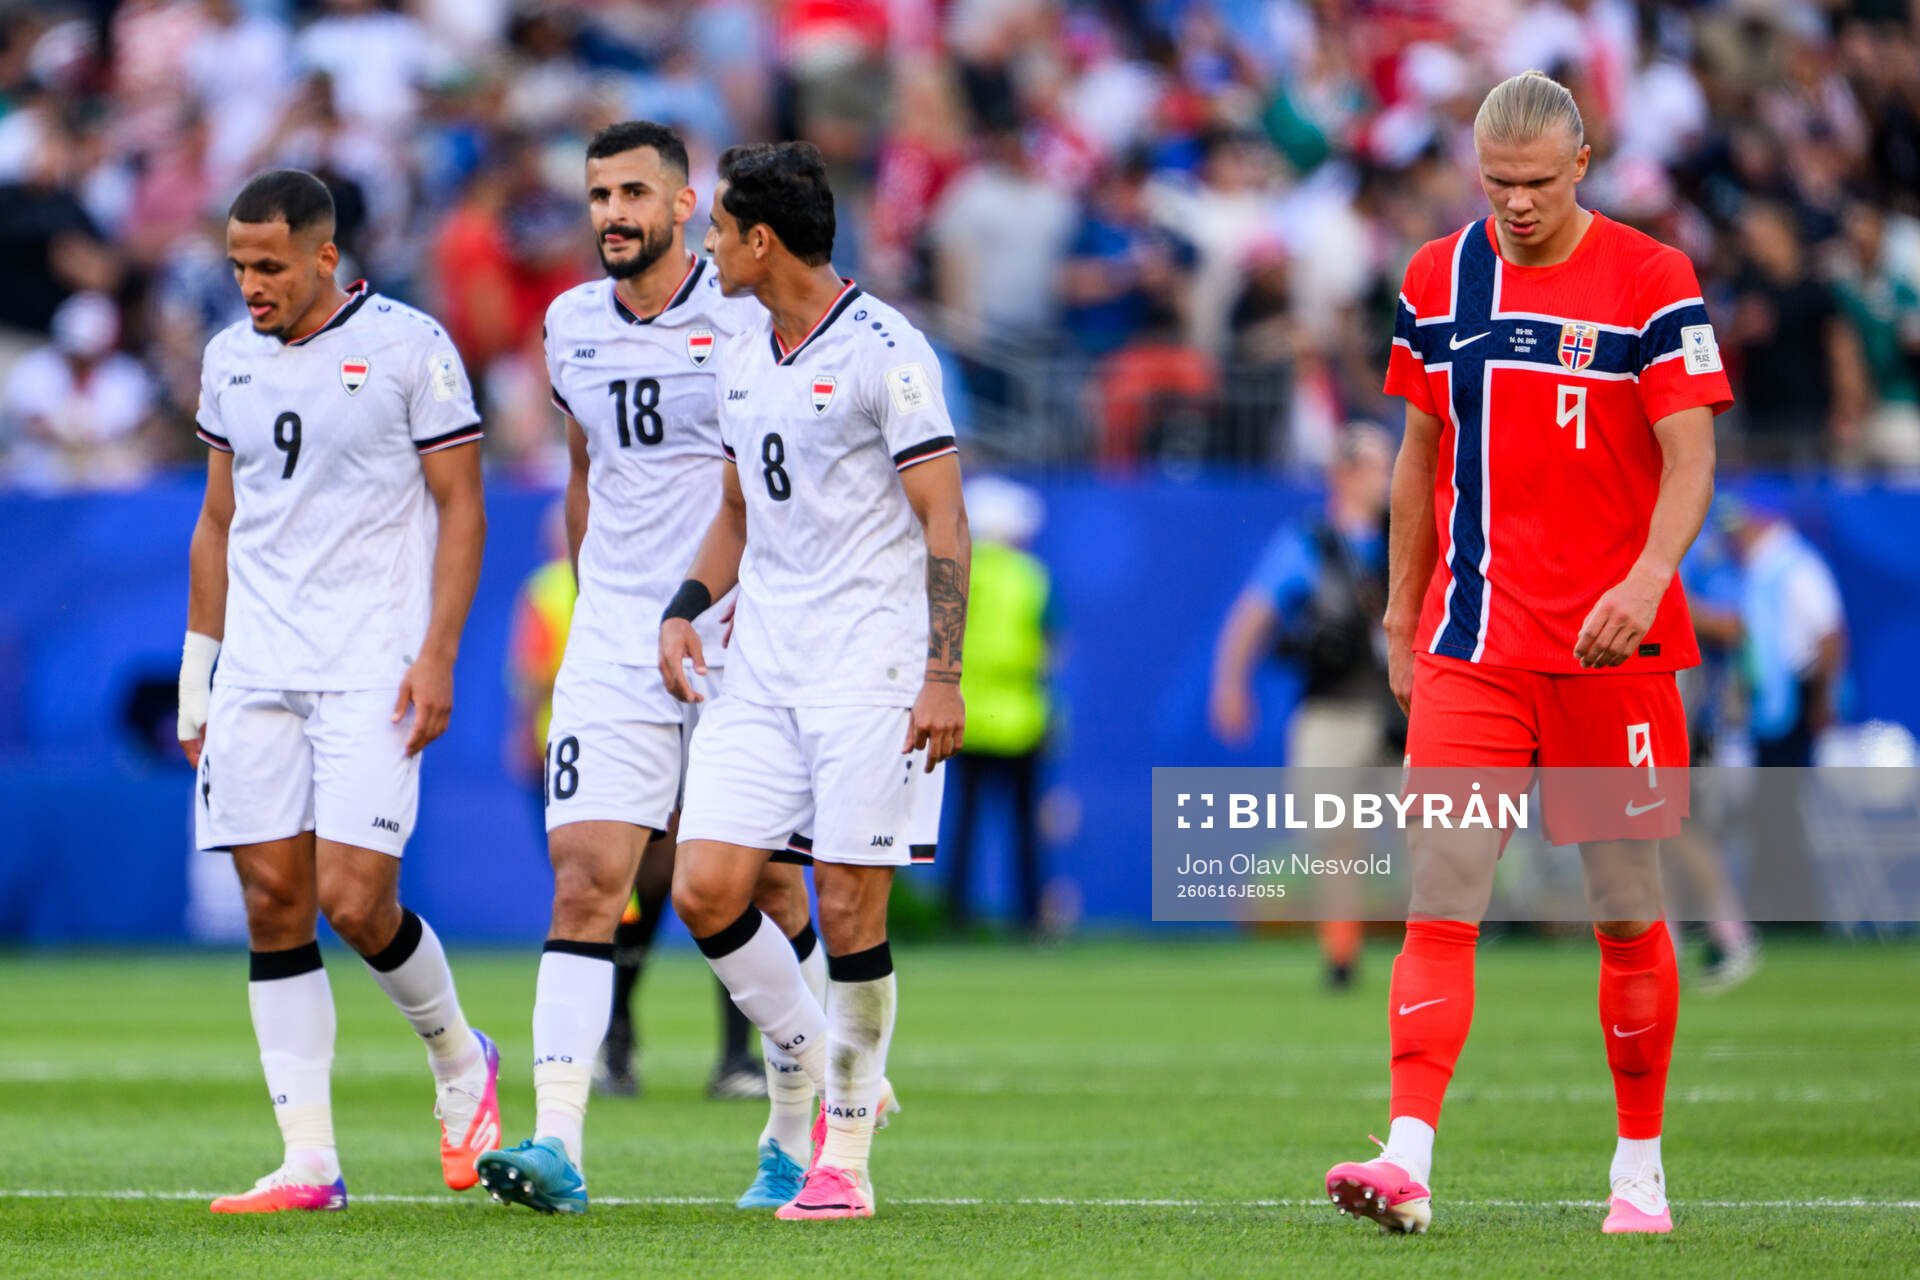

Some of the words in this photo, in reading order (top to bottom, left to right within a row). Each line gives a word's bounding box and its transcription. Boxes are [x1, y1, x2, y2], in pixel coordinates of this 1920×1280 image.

[608, 378, 664, 447] 18
[1556, 384, 1587, 449] 9
[273, 411, 302, 480] 9
[762, 432, 792, 501] 8
[1626, 722, 1657, 788] 9
[371, 816, 400, 833] JAKO
[870, 834, 894, 847] JAKO
[535, 1055, 573, 1066] AKO
[826, 1103, 867, 1118] JAKO
